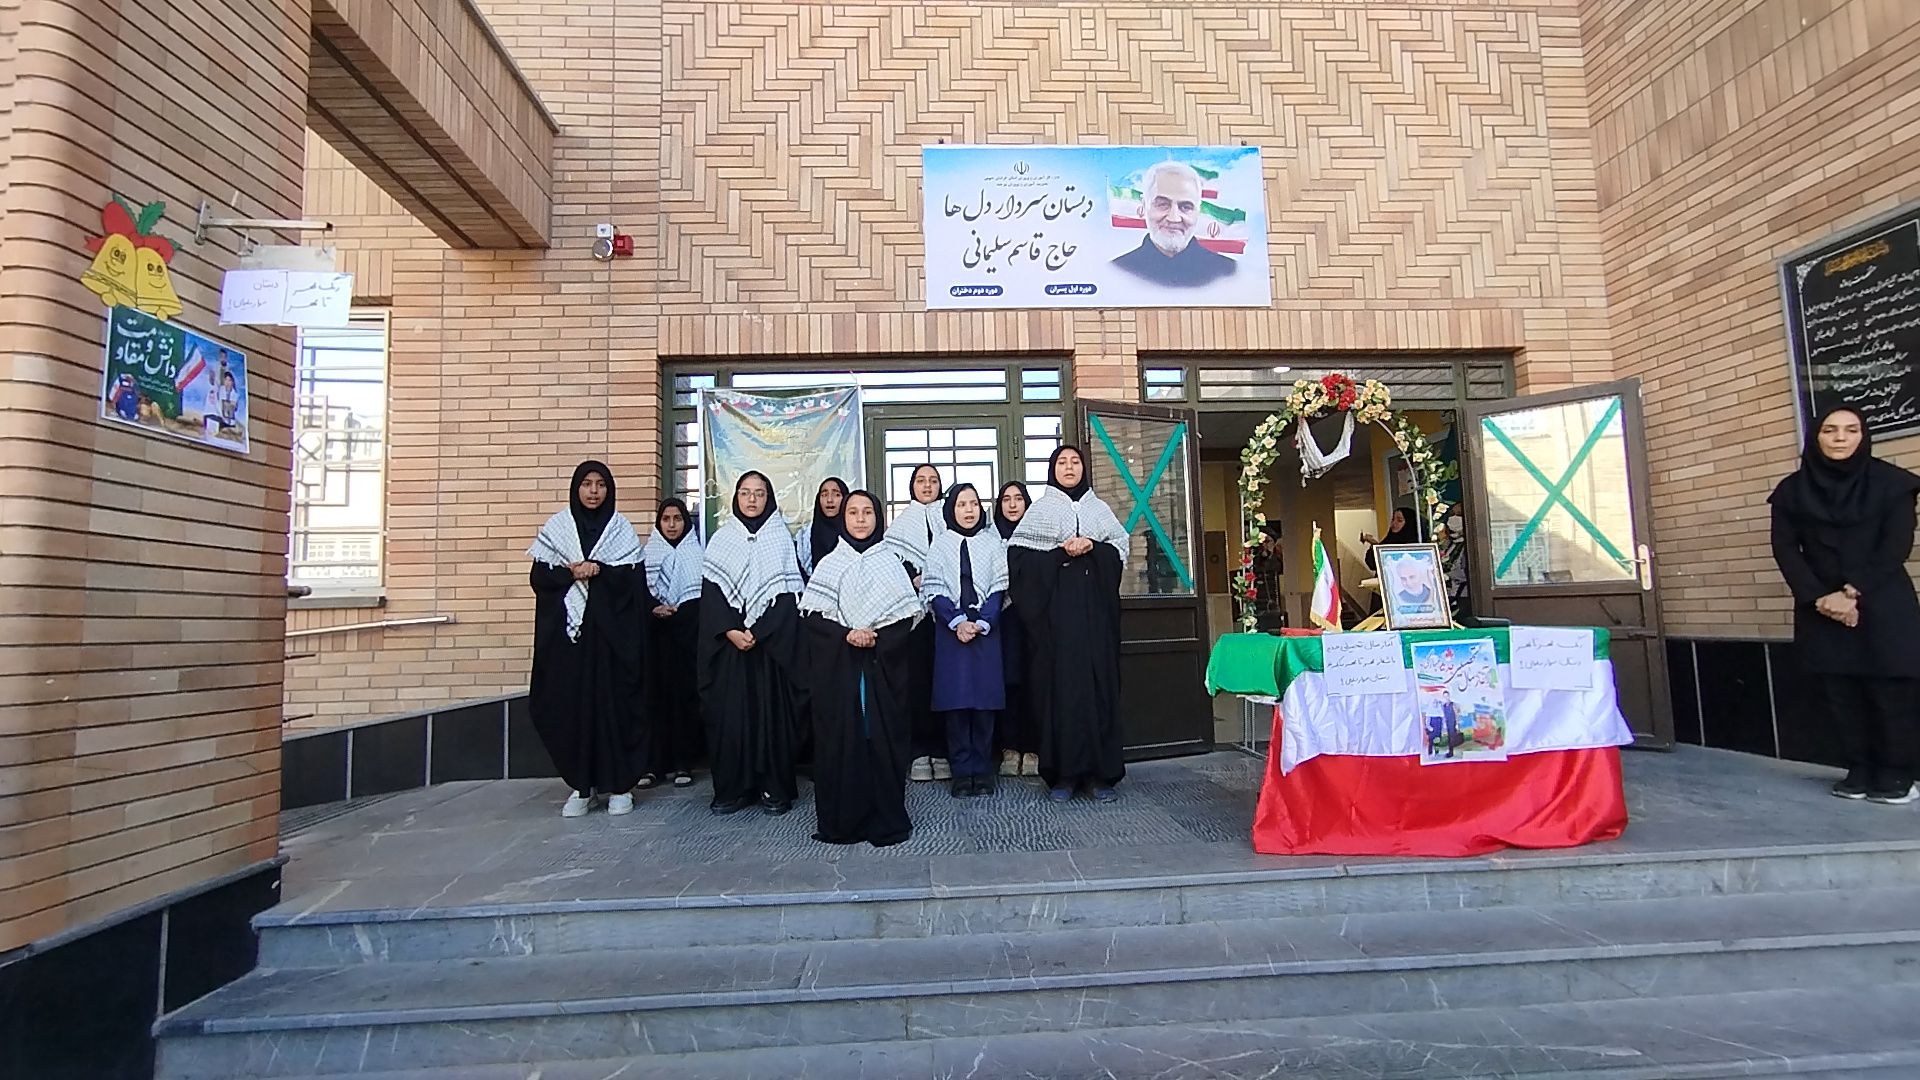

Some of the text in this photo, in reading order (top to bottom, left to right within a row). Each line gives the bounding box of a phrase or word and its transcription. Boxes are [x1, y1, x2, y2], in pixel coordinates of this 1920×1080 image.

[944, 185, 1093, 222] دبستان سردار دل ها
[963, 229, 1078, 274] حاج قاسم سلیمانی
[952, 286, 998, 296] دوره دوم دختران
[1049, 285, 1092, 294] دوره اول پسران
[144, 338, 176, 378] دانش
[146, 340, 153, 352] و
